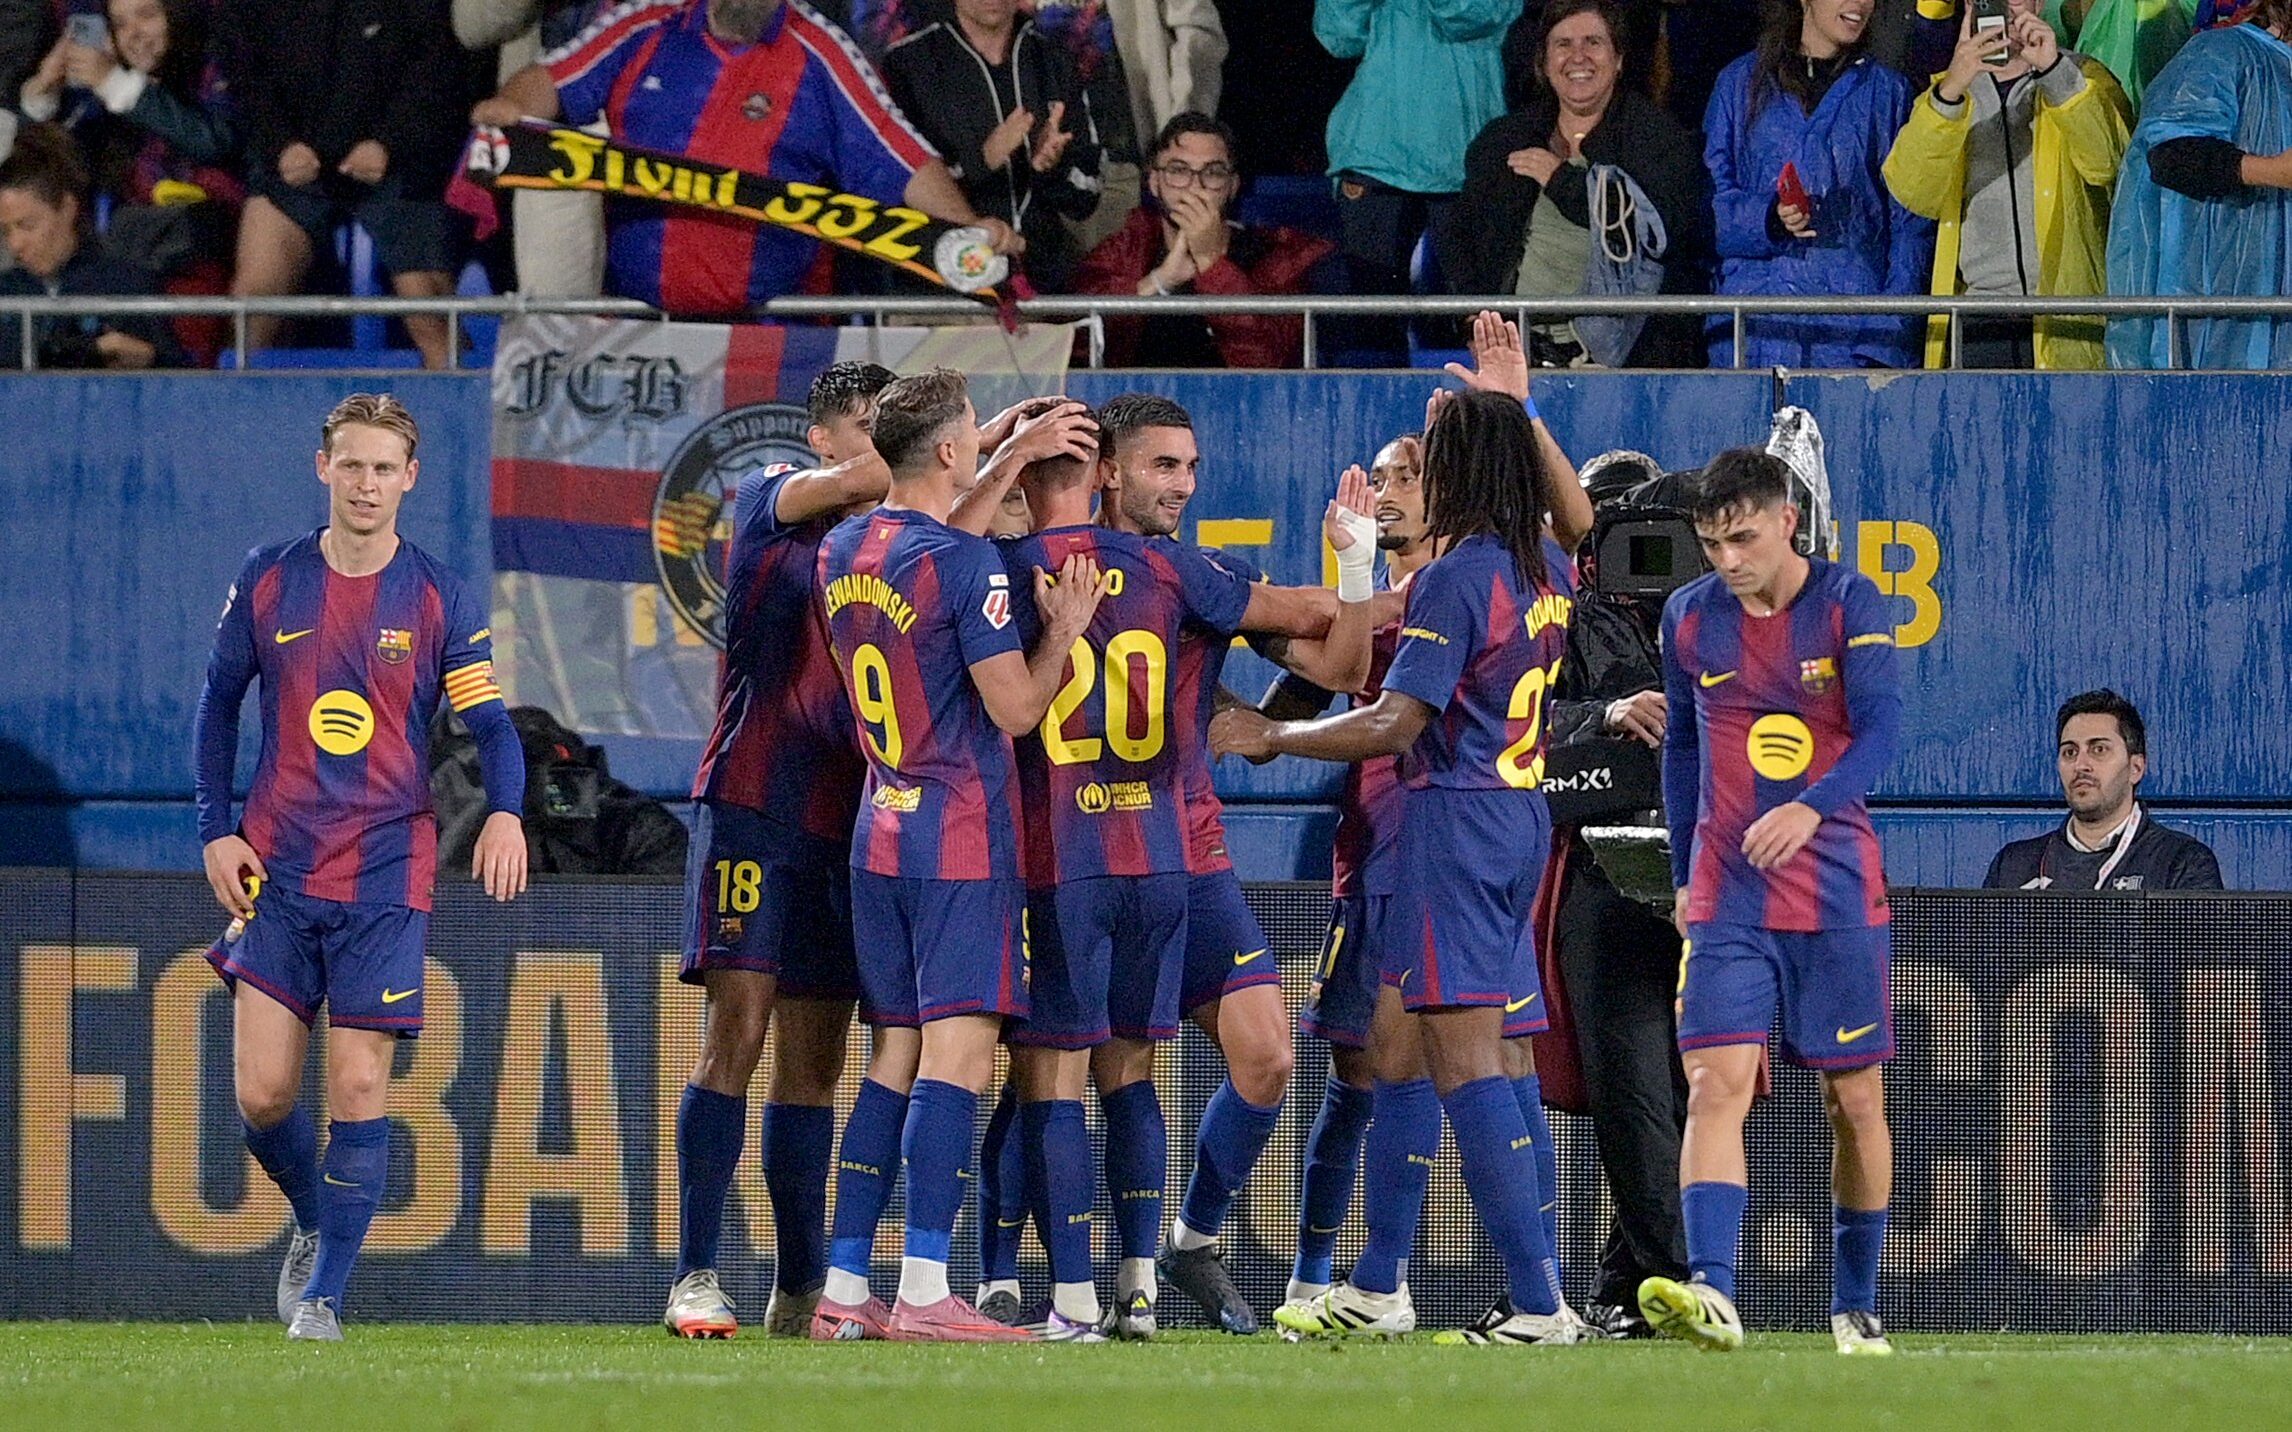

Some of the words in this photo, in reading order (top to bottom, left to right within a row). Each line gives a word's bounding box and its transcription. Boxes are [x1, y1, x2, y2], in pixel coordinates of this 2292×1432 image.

[505, 349, 692, 423] FCB
[852, 643, 903, 771] 9
[1039, 629, 1167, 766] 20
[714, 859, 762, 914] 18
